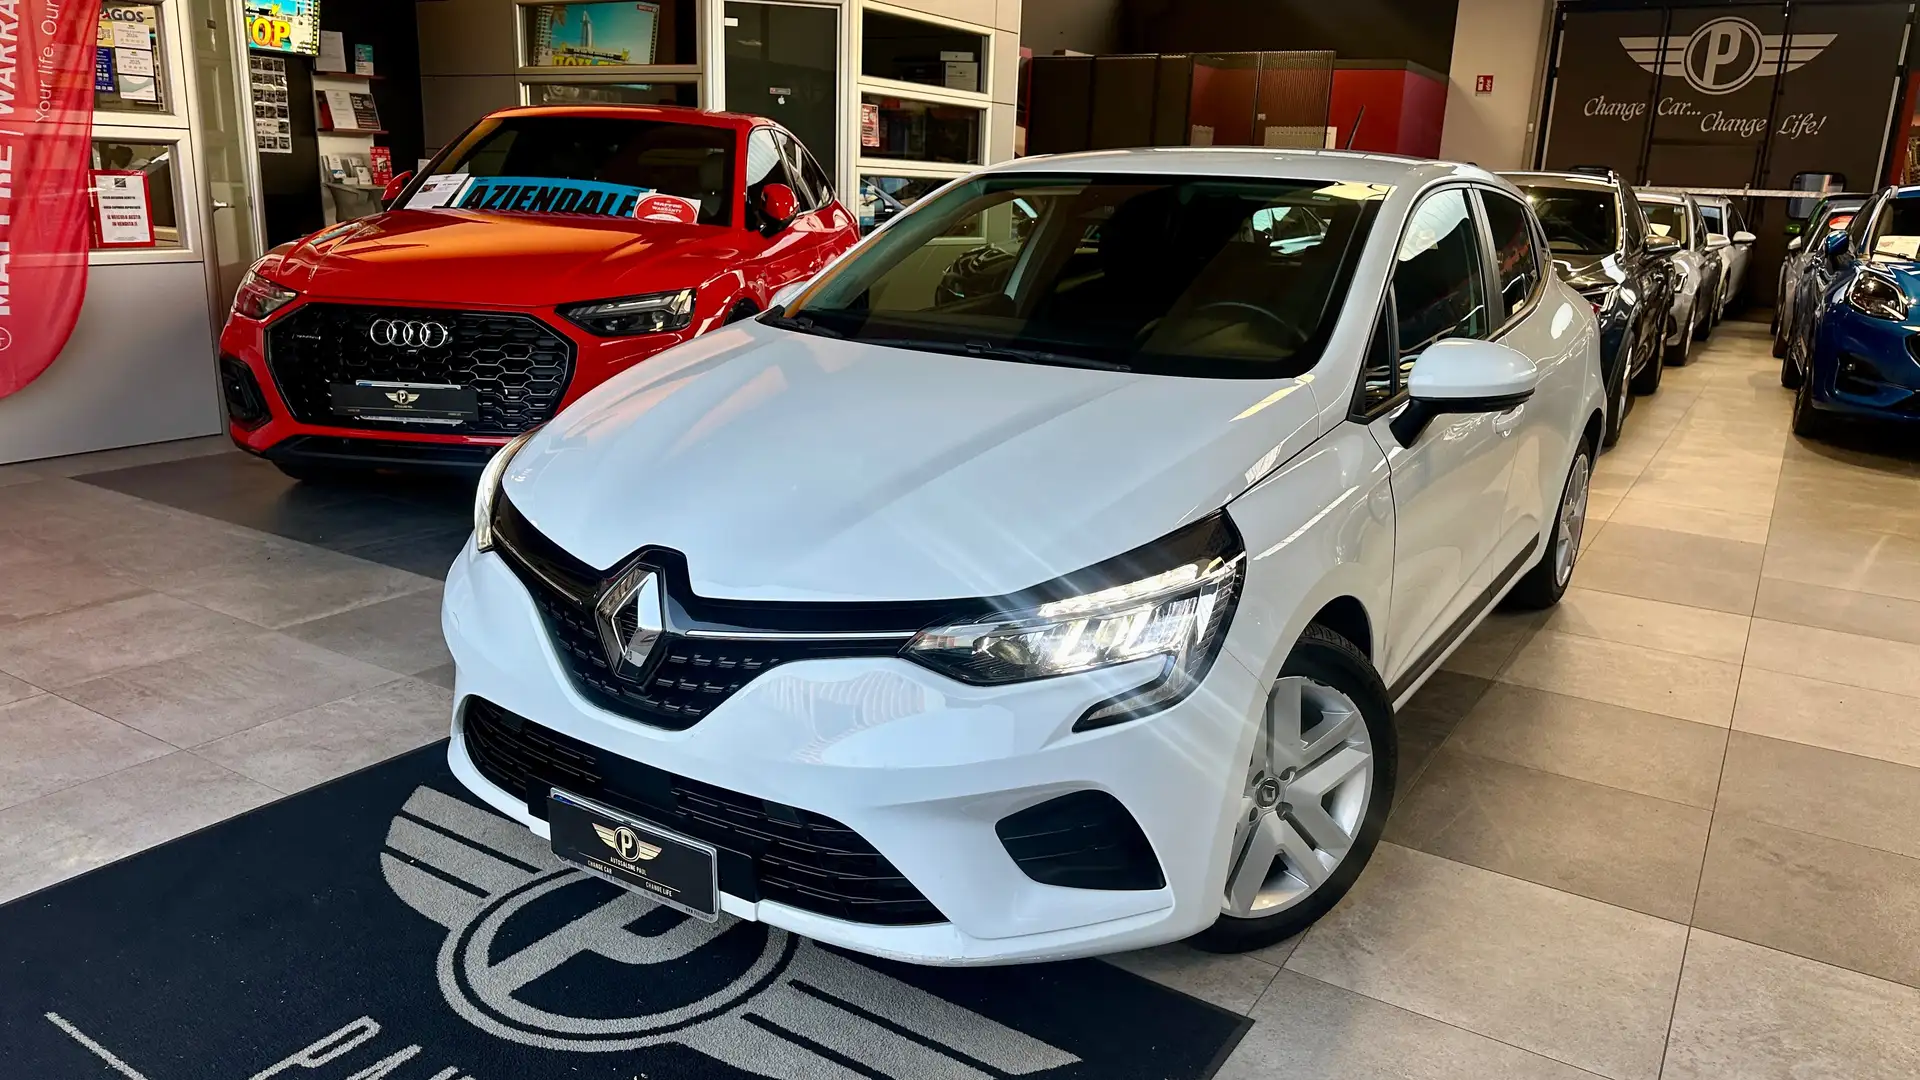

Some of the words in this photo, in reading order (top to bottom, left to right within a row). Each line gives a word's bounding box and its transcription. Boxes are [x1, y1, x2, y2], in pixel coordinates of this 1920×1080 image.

[41, 0, 59, 35] Our
[100, 8, 144, 23] AGOS
[246, 16, 290, 48] OP
[37, 43, 54, 75] life.
[35, 80, 52, 122] Your
[1584, 95, 1646, 121] Change
[1657, 97, 1701, 116] Car...
[1700, 111, 1767, 138] Change
[1776, 112, 1827, 139] Life!
[587, 860, 604, 872] CHANGE
[603, 866, 613, 874] CAR
[609, 856, 636, 872] AUTOSALONE
[645, 881, 662, 893] CHANGE
[662, 887, 672, 897] LIFE
